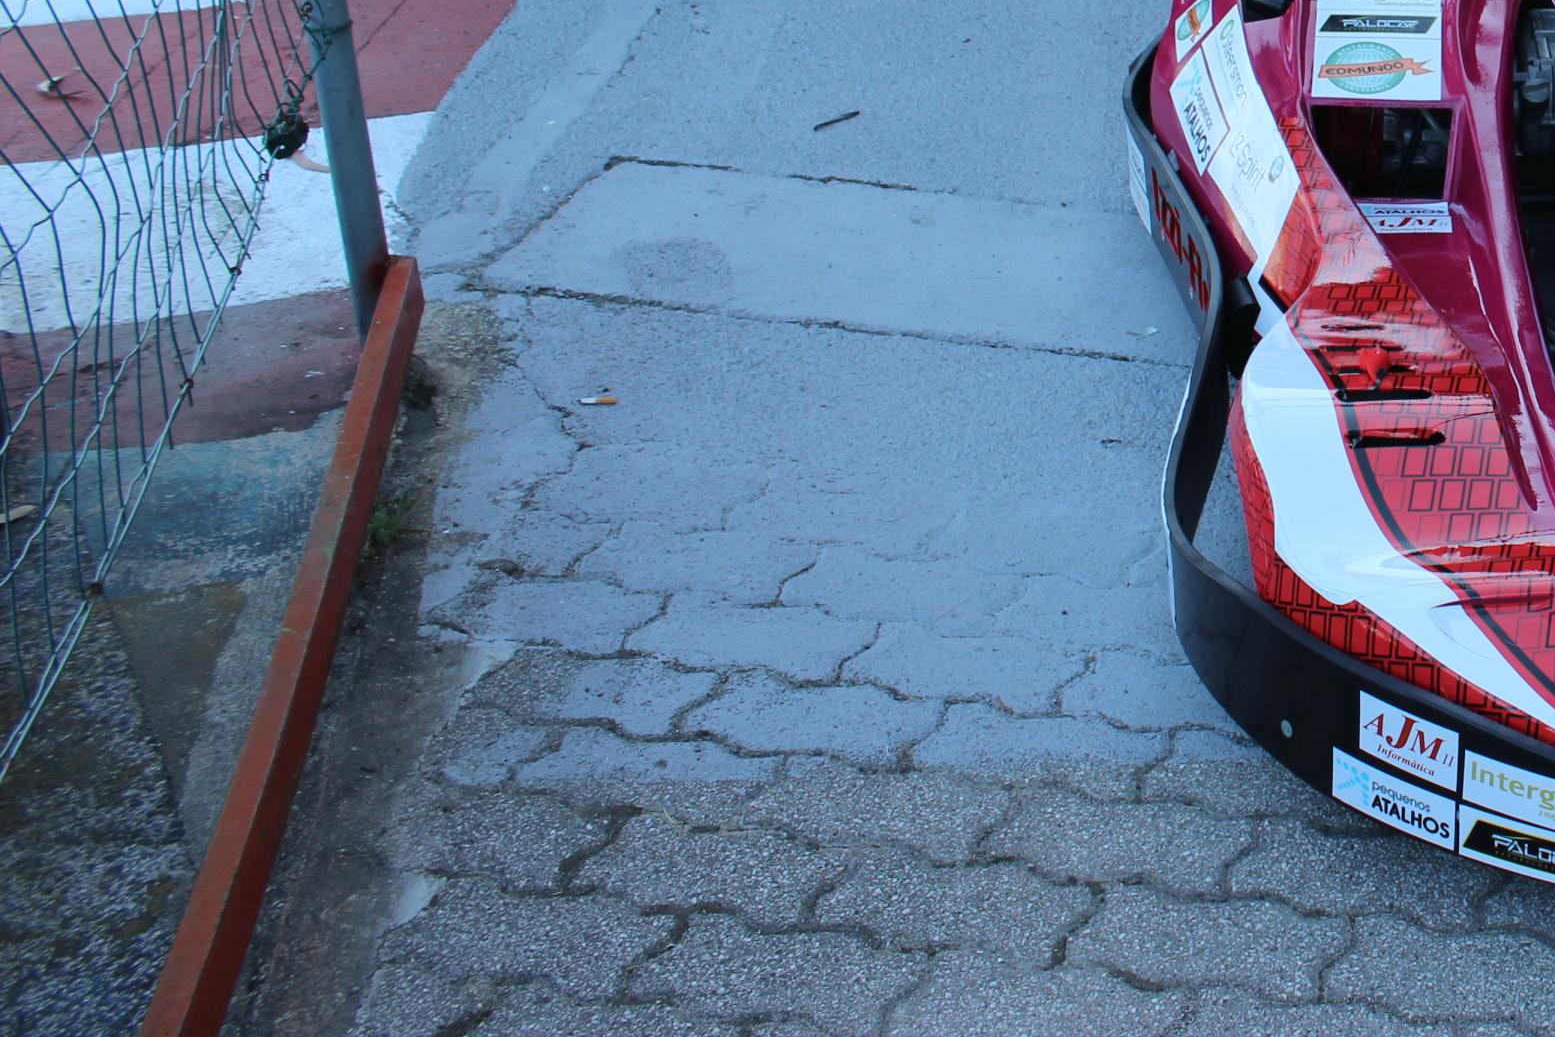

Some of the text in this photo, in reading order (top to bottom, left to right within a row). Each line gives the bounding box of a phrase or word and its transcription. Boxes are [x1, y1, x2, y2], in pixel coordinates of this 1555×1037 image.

[1341, 19, 1419, 29] PALOCAR
[1325, 61, 1404, 75] EDMUNDO
[1183, 103, 1212, 163] ATALHOS
[1363, 712, 1444, 762] AJM
[1377, 743, 1435, 777] Informática
[1371, 781, 1431, 813] pequenos
[1371, 794, 1450, 839] ATALHOS
